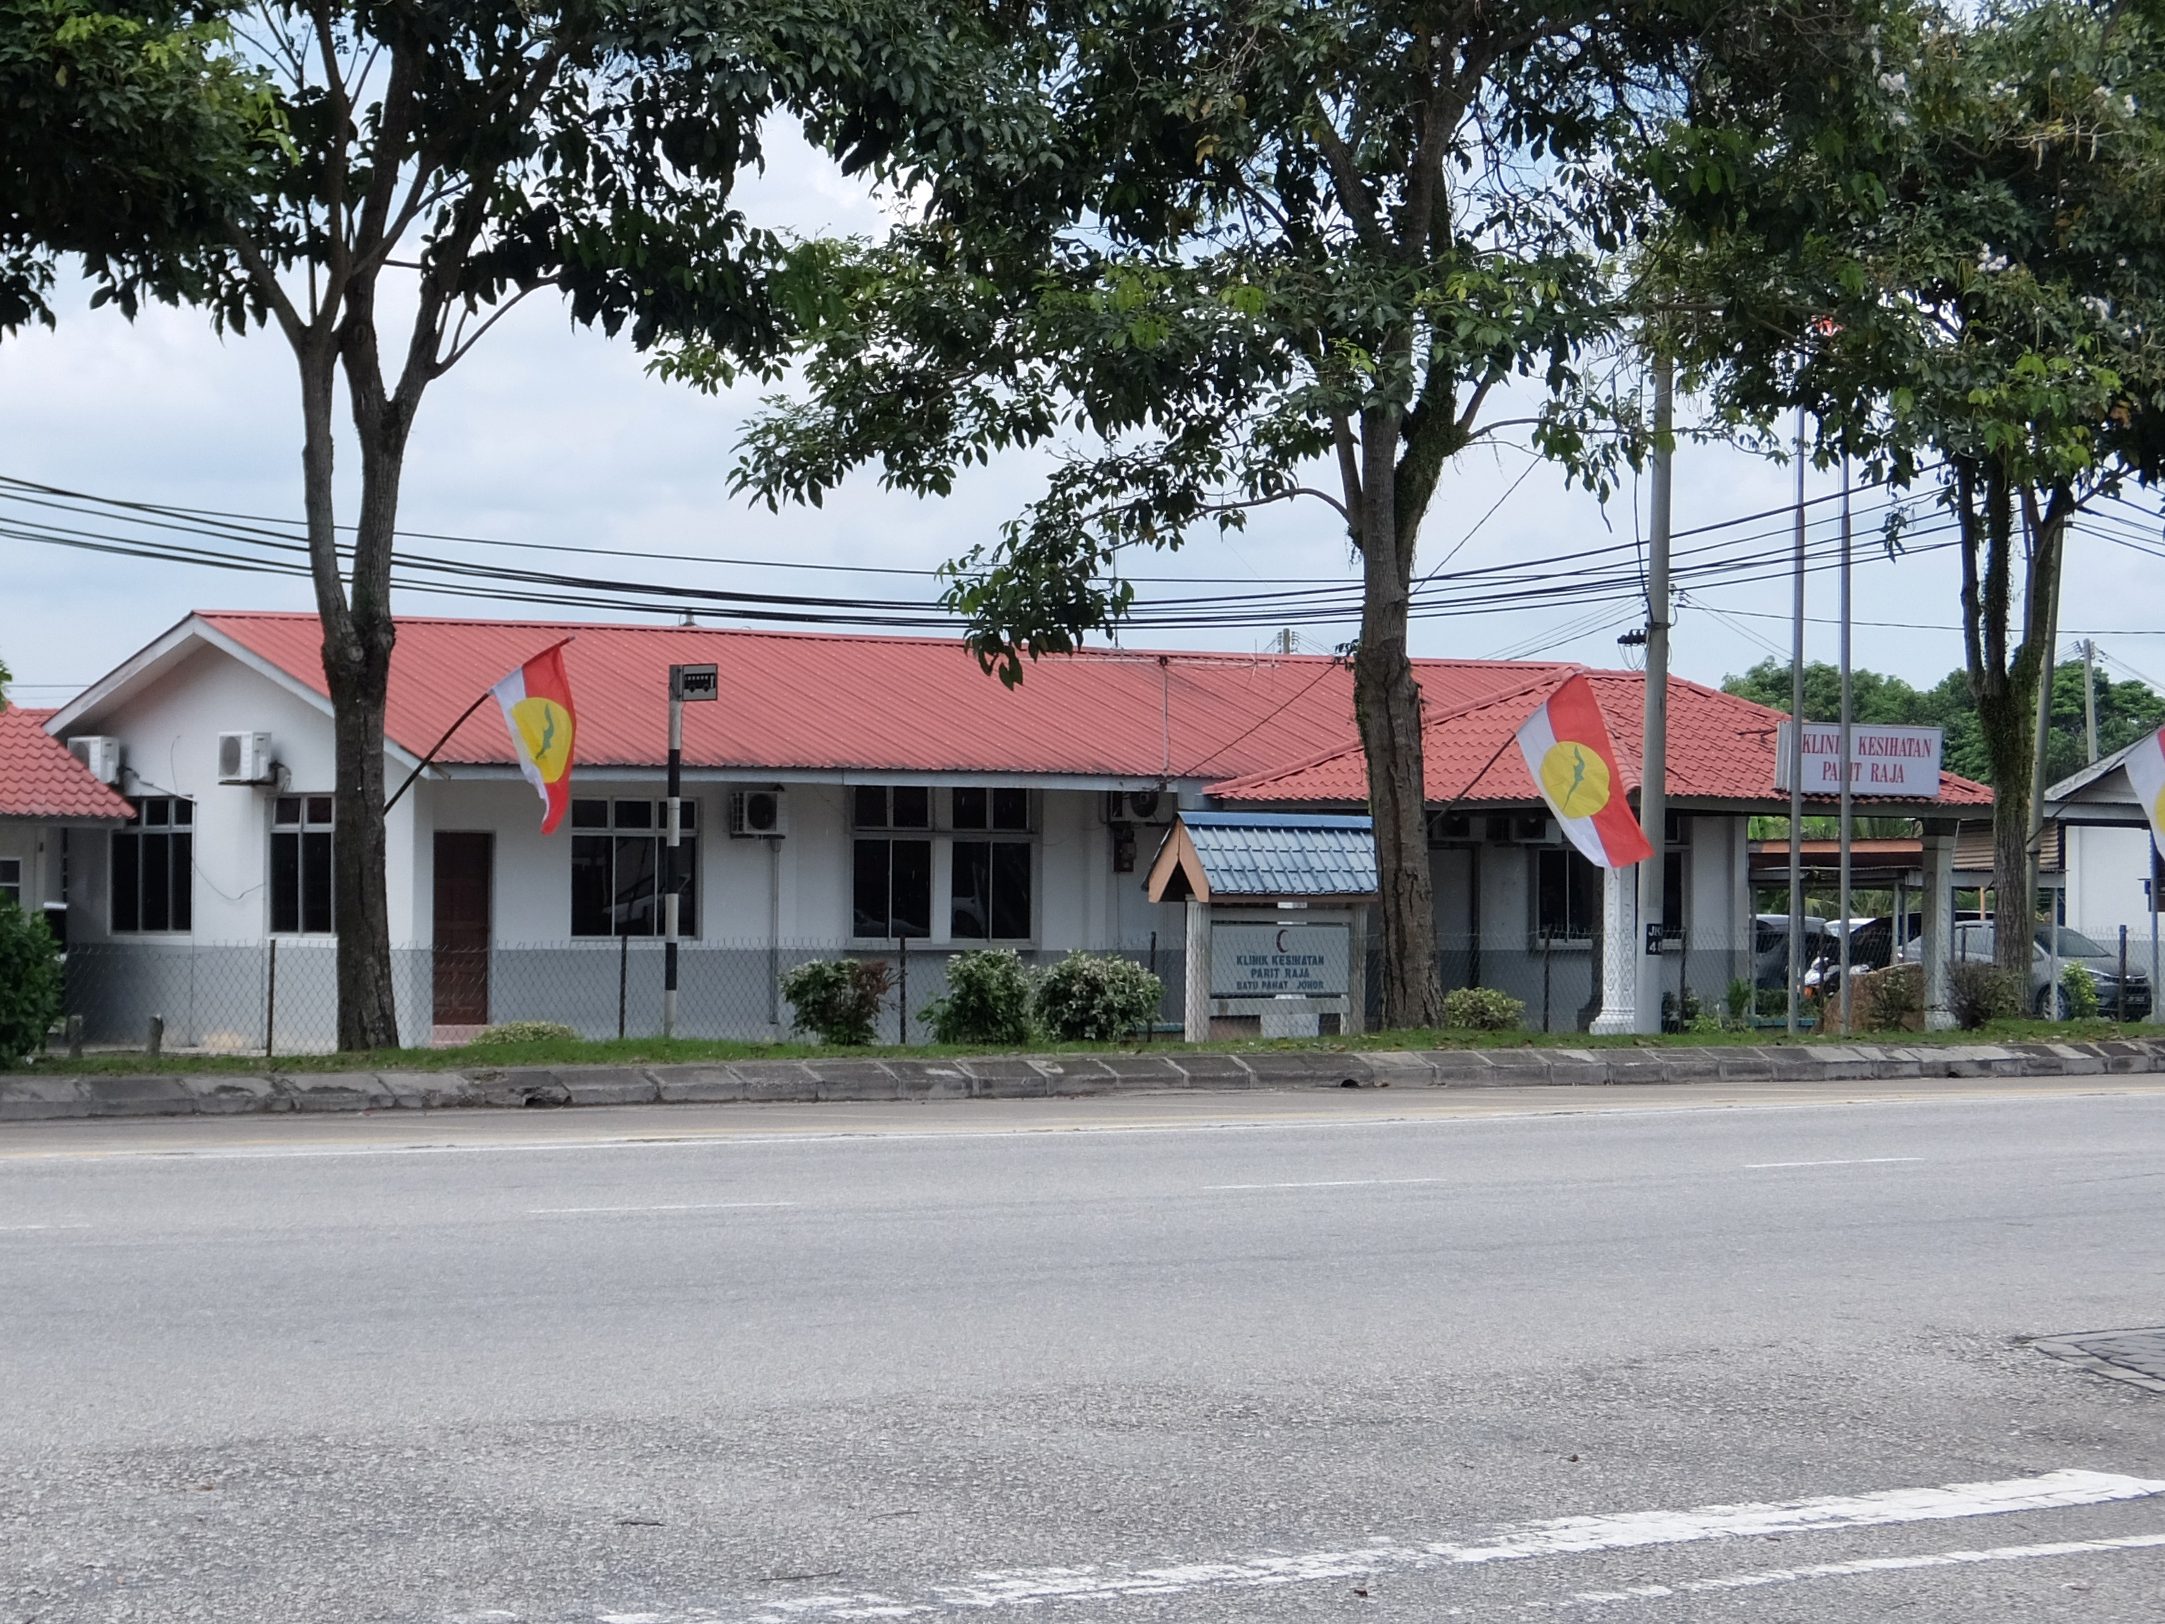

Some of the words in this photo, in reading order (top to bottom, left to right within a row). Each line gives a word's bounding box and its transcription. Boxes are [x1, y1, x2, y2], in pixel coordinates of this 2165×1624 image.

[1802, 734, 1846, 755] KLINI
[1858, 735, 1931, 758] KESIHATAN
[1871, 762, 1904, 783] RAJA
[1236, 955, 1269, 966] KLINIK
[1271, 955, 1325, 966] KESIHATAN
[1251, 968, 1280, 979] PARIT
[1284, 968, 1310, 979] RAJA
[1236, 981, 1259, 991] BATU
[1261, 981, 1288, 991] PAHAT
[1297, 980, 1325, 990] JOHOR
